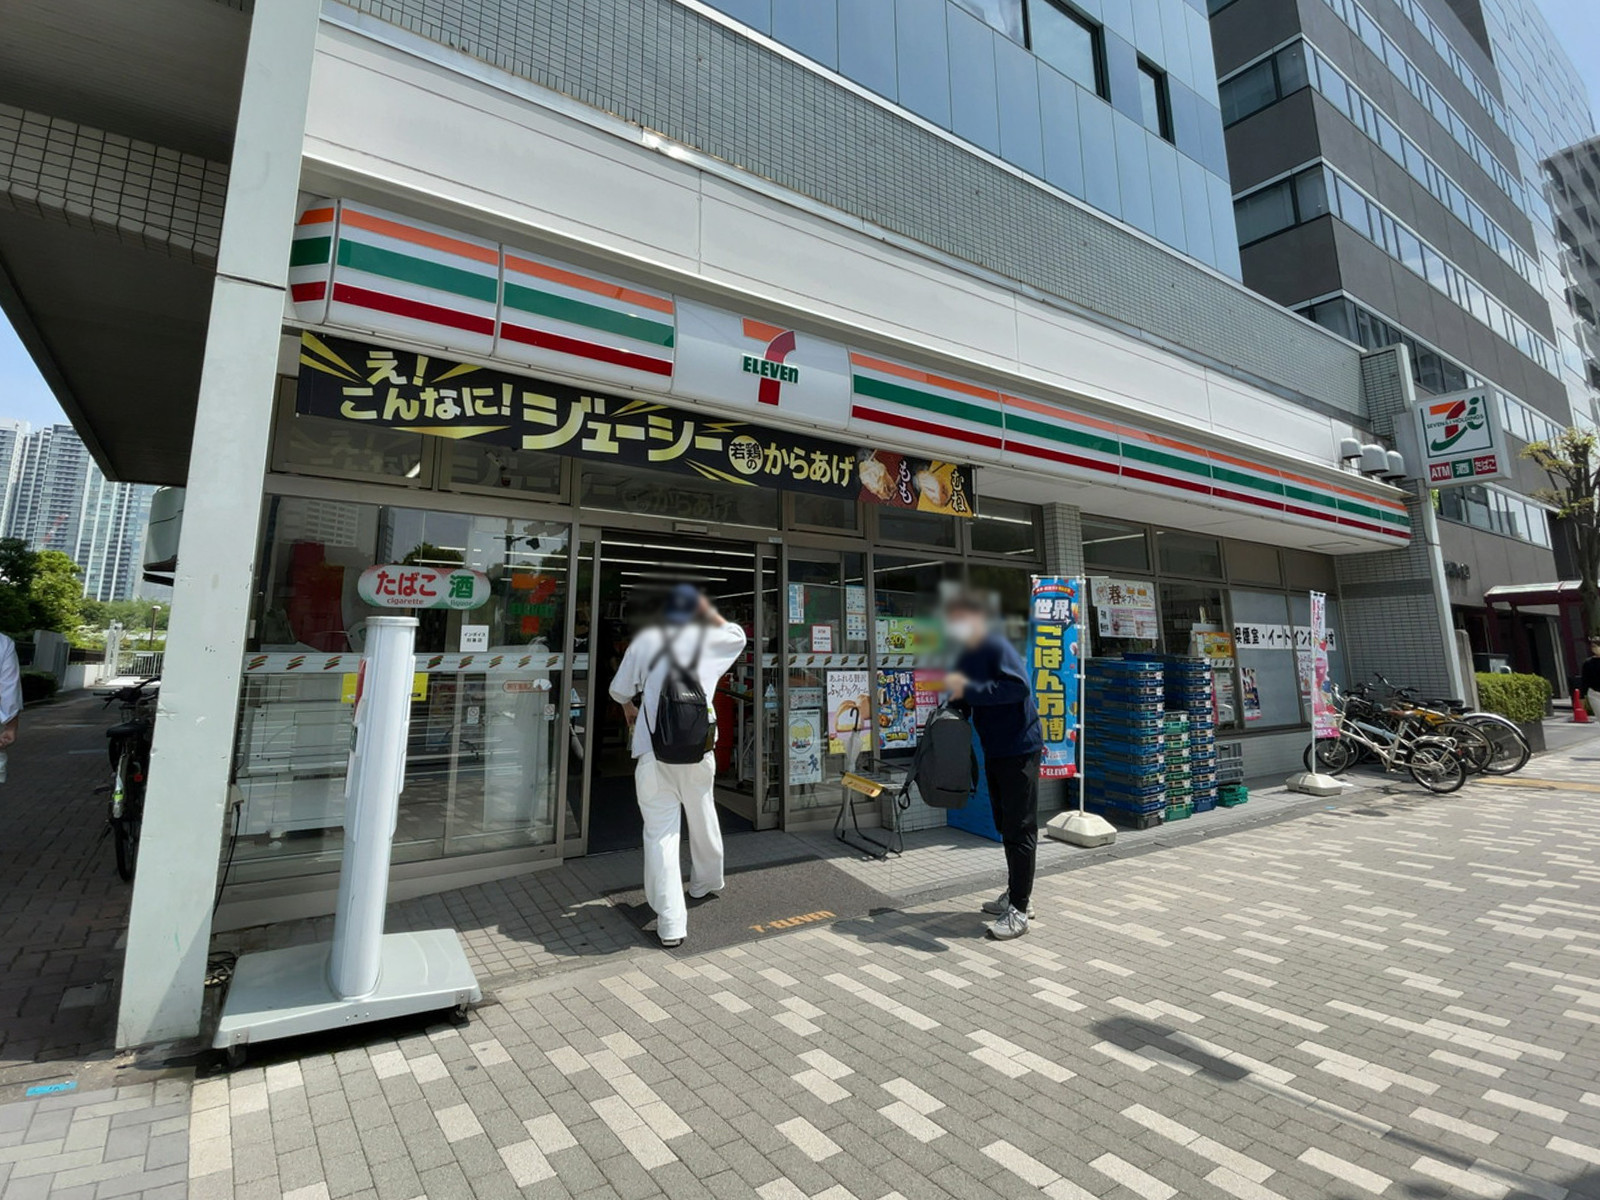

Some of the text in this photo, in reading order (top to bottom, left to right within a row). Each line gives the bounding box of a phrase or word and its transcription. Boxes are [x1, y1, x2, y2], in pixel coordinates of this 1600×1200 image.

[522, 391, 722, 461] ジューシー
[731, 442, 855, 487] 若鶏の からあげ
[1431, 464, 1452, 478] ATM
[1455, 462, 1469, 475] 酒
[899, 460, 912, 503] もも
[952, 469, 967, 512] むね
[375, 570, 437, 596] たばこ
[448, 575, 474, 599] 酒
[1034, 598, 1070, 620] 世界
